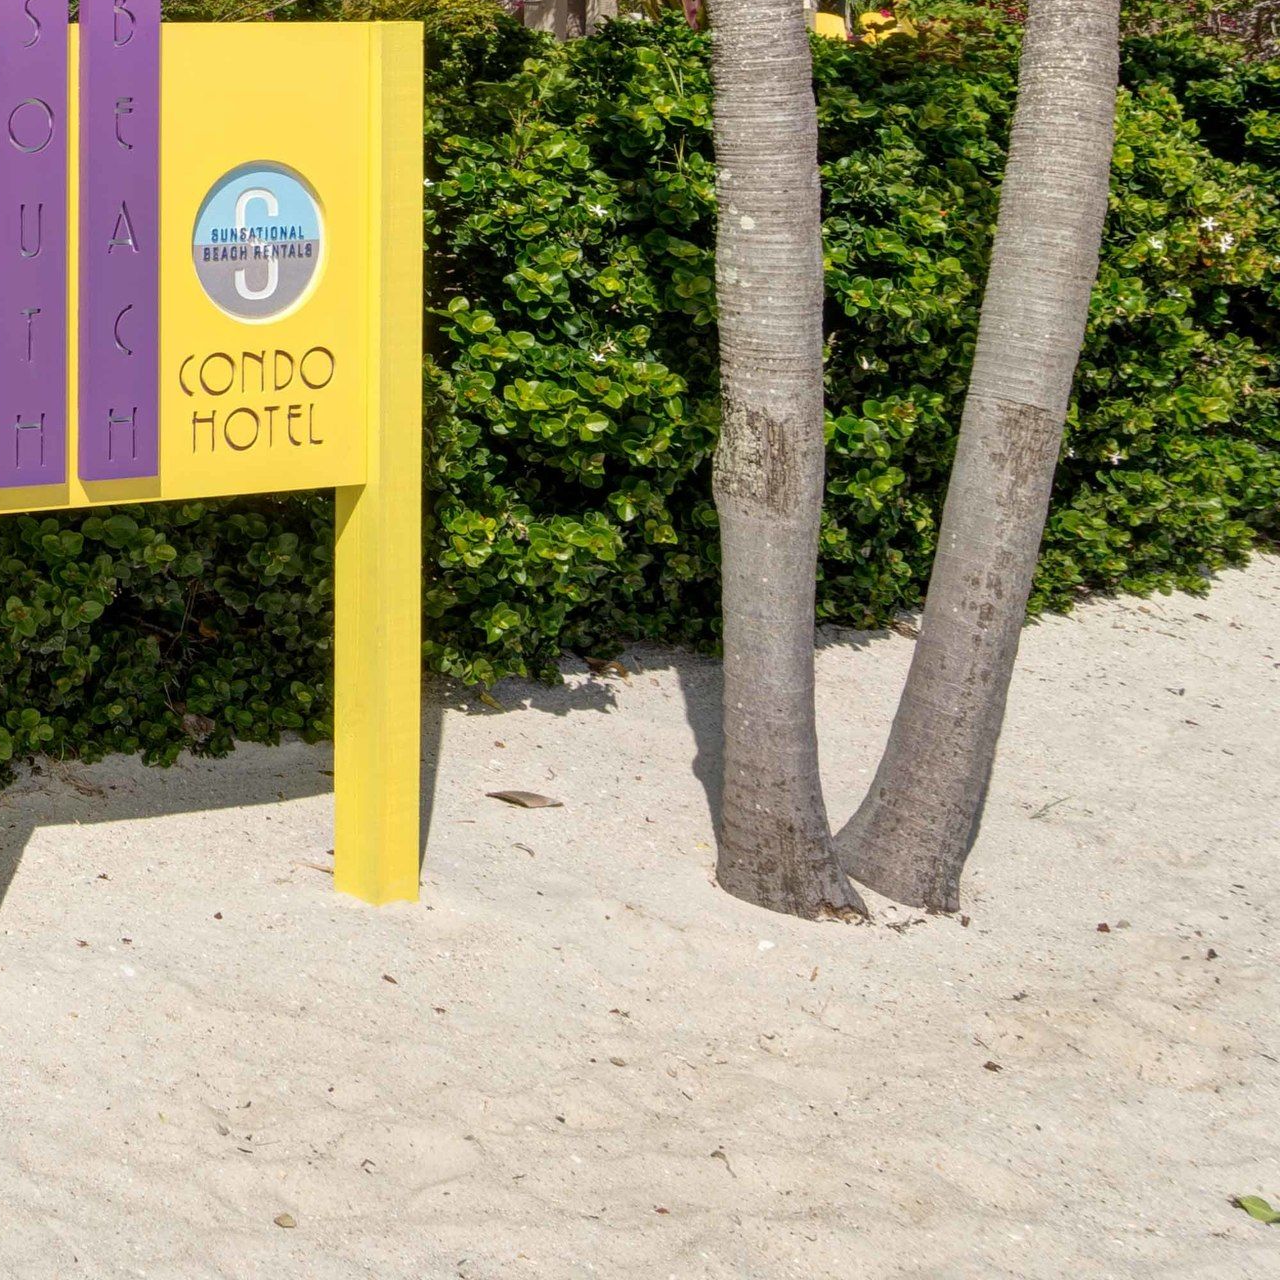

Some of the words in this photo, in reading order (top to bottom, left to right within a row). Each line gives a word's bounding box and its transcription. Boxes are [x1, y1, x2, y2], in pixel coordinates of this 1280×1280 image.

[203, 246, 248, 262] BEACH
[253, 243, 313, 260] RENTALS
[211, 226, 305, 244] SUNSATIONAL
[179, 346, 336, 397] CONDO
[192, 403, 324, 454] HOTEL
